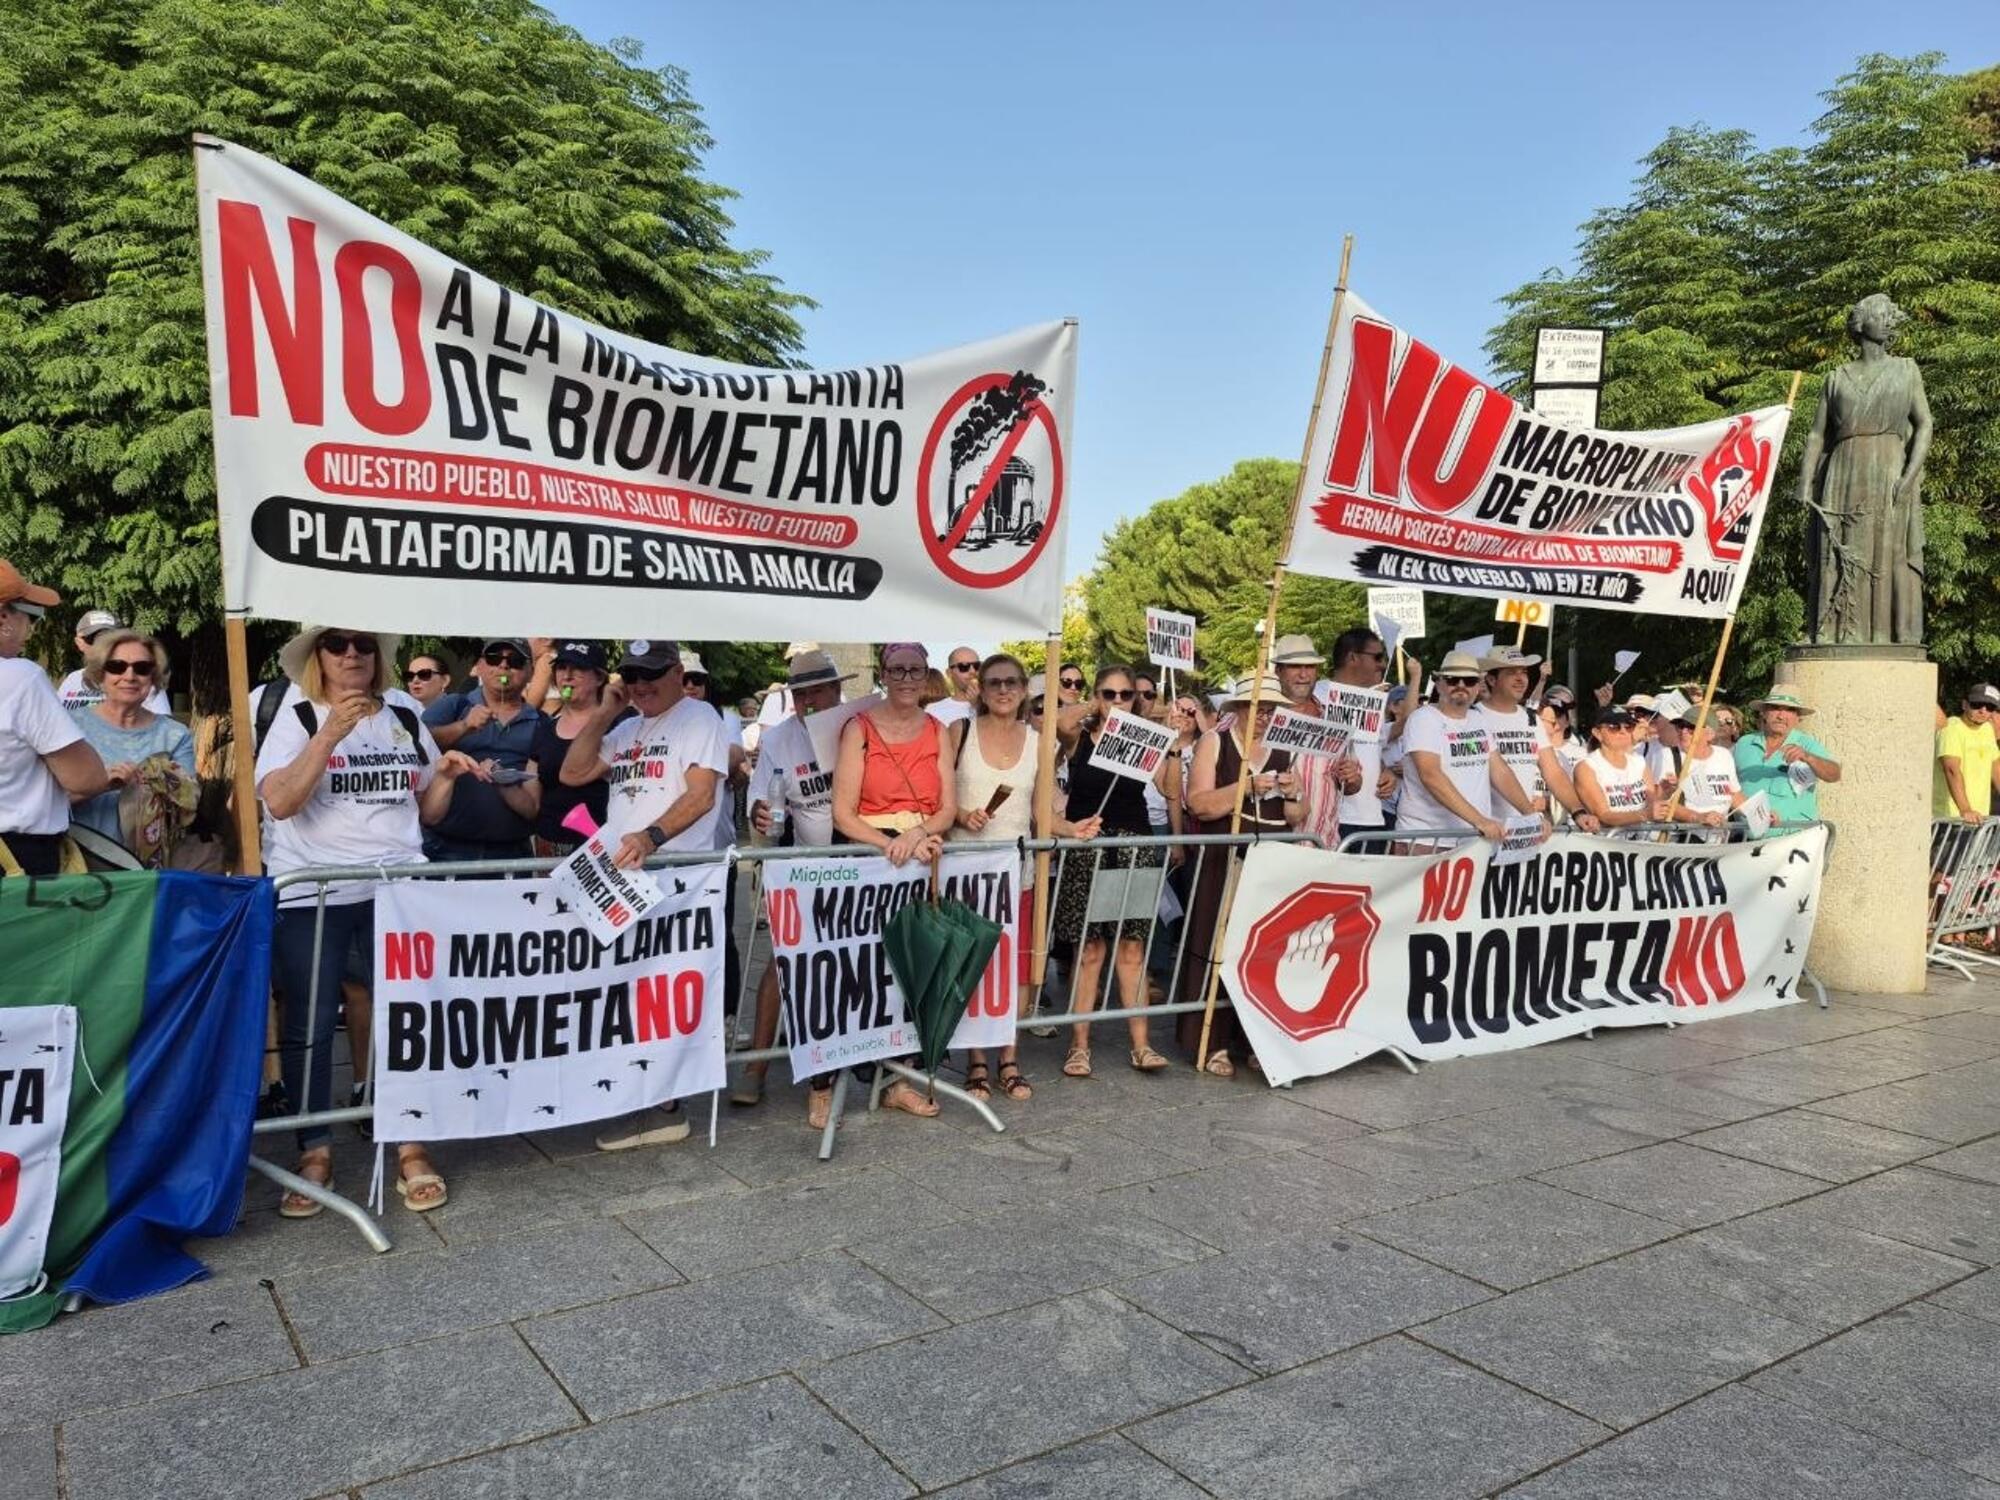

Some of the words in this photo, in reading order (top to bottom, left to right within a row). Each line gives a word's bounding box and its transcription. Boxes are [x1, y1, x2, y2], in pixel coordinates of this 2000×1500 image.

[219, 199, 431, 436] NO
[436, 268, 473, 337] A
[494, 287, 560, 364] LA
[435, 343, 531, 451] DE
[547, 375, 904, 507] BIOMETANO
[1325, 318, 1515, 513] NO
[1499, 419, 1697, 494] MACROPLANTA
[323, 451, 437, 492] NUESTRO
[445, 463, 537, 505] PUEBLO,
[541, 474, 626, 513] NUESTRA
[627, 492, 686, 526] SALUD,
[689, 500, 772, 533] NUESTRO
[775, 516, 846, 543] FUTURO
[1476, 473, 1537, 525] DE
[1529, 484, 1694, 538] BIOMETANO
[1723, 481, 1754, 527] STOP
[288, 508, 575, 575] PLATAFORMA
[586, 534, 633, 577] DE
[643, 540, 747, 586] SANTA
[750, 552, 855, 593] AMALIA
[1341, 502, 1403, 537] HERNÁN
[1454, 528, 1505, 557] CONTRA
[1502, 538, 1520, 559] LA
[1521, 540, 1574, 562] PLANTA
[1576, 545, 1598, 564] DE
[1598, 545, 1673, 567] BIOMETANO
[1378, 553, 1397, 578] NI
[1401, 557, 1425, 581] EN
[1428, 562, 1450, 583] TU
[1451, 567, 1531, 592] PUEBLO,
[1531, 572, 1552, 591] NI
[1555, 574, 1578, 594] EN
[1580, 575, 1598, 596] EL
[1599, 573, 1628, 599] MÍO
[1504, 597, 1542, 624] NO
[1266, 726, 1343, 753] BIOMETANO
[1273, 714, 1287, 727] NO
[1288, 718, 1349, 740] MACROPLANTA
[1327, 704, 1380, 732] BIOMETANO
[328, 755, 346, 769] NO
[331, 770, 420, 793] BIOMETAN
[1096, 733, 1161, 772] BIOMETANO
[570, 853, 630, 927] BIOMETANO
[588, 839, 604, 856] NO
[597, 851, 648, 914] MACROPLANTA
[789, 864, 859, 886] Miajadas
[1417, 856, 1474, 923] NO
[1480, 851, 1728, 919] MACROPLANTA
[385, 930, 435, 980] NO
[449, 906, 715, 979] MACROPLANTA
[766, 886, 802, 948] NO
[1407, 911, 1746, 1044] BIOMETANO
[387, 969, 705, 1073] BIOMETANO
